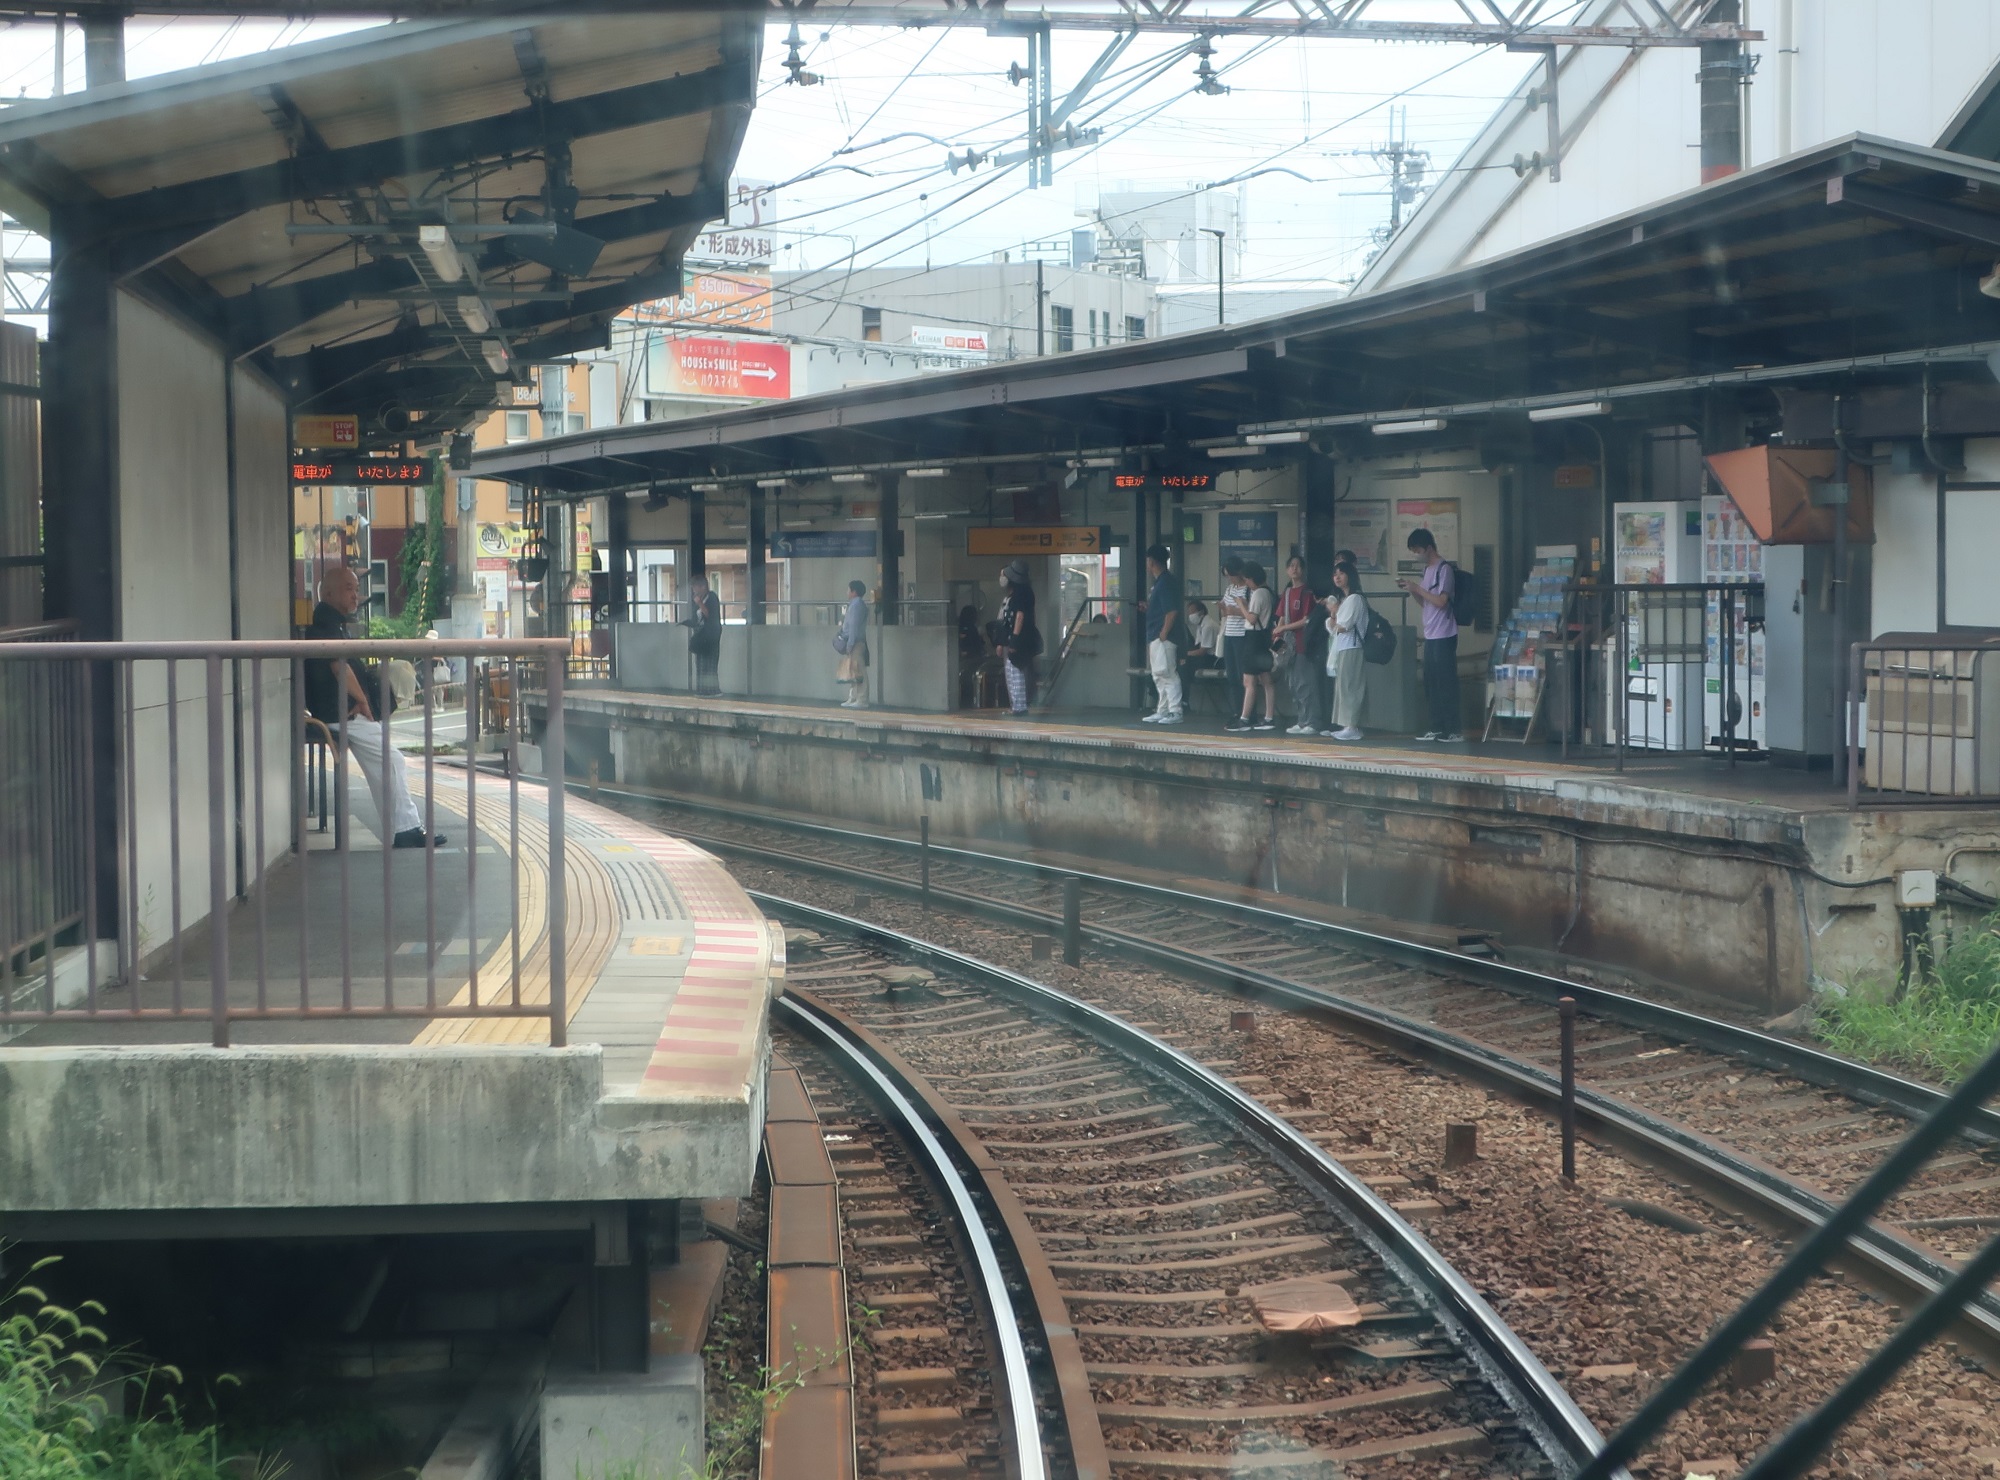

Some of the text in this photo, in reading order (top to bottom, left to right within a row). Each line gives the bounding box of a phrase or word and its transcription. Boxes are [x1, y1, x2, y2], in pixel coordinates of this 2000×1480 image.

[699, 277, 734, 296] 350m
[700, 372, 739, 389] ハウスマイル
[335, 422, 353, 430] STOP
[293, 464, 423, 480] 電車が いたします
[1114, 475, 1210, 488] 電車が いたします
